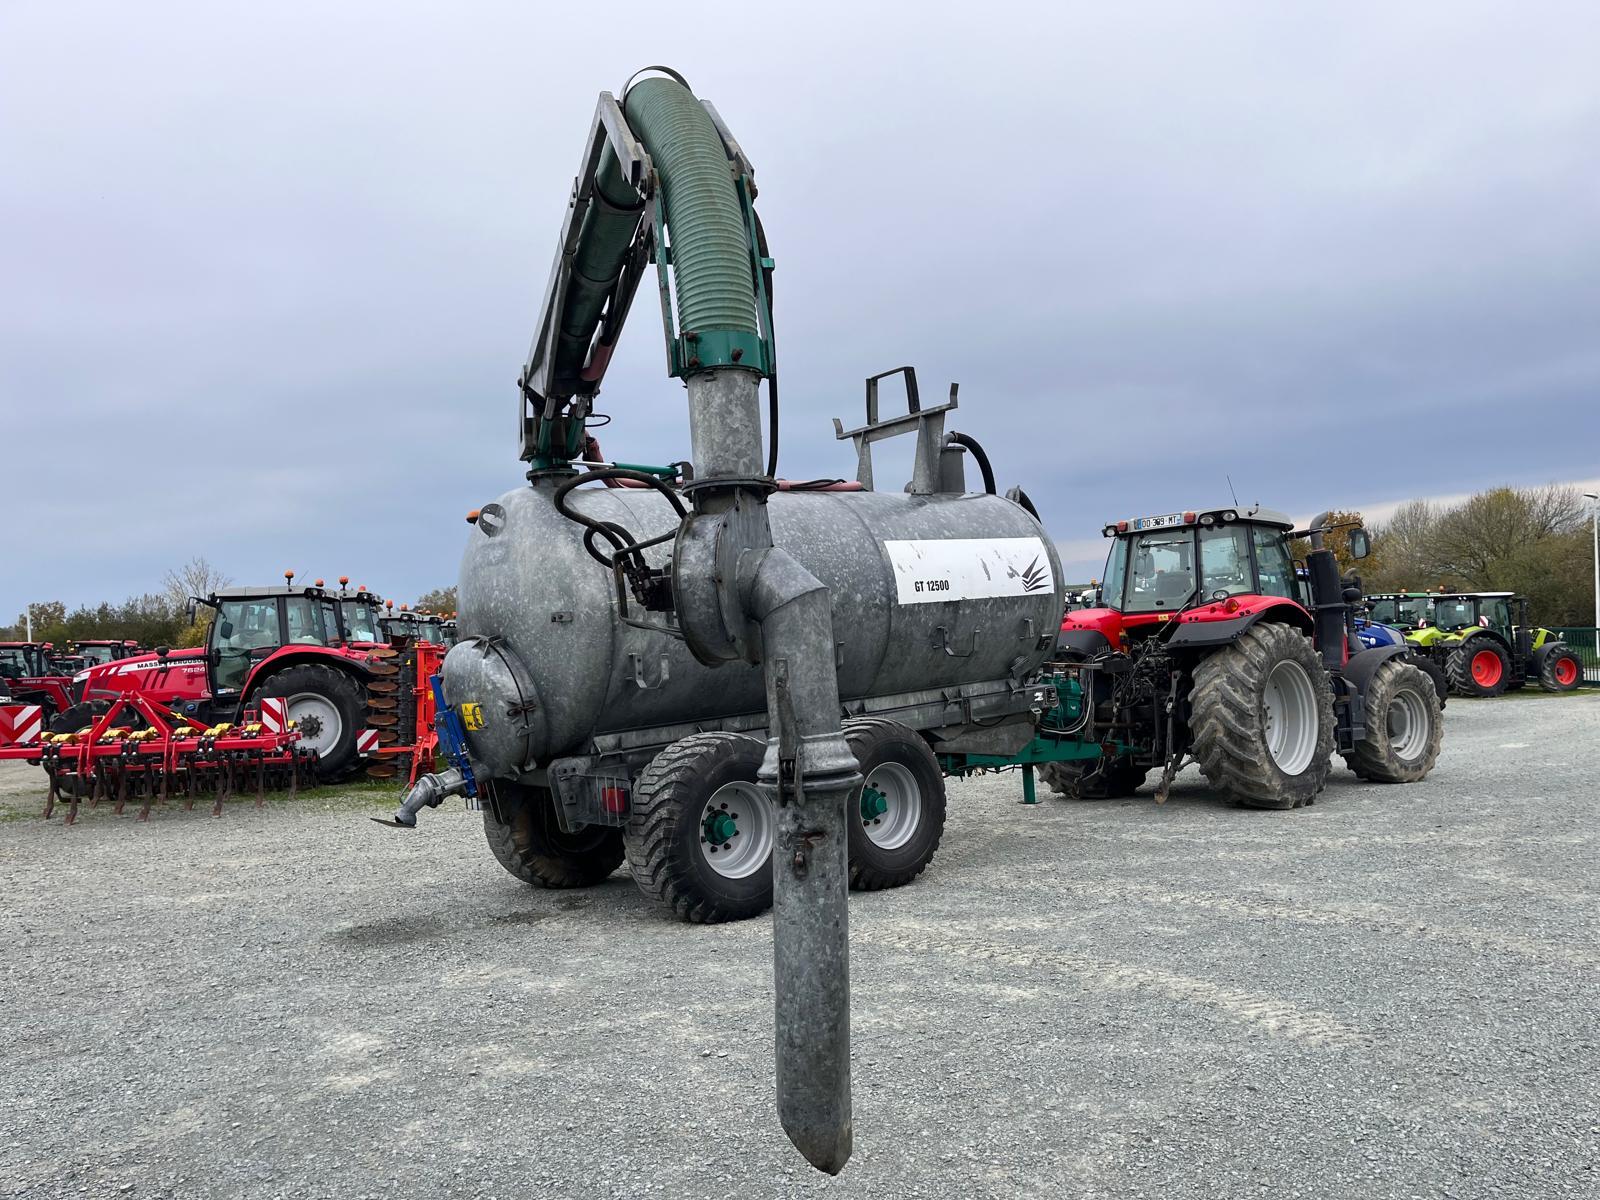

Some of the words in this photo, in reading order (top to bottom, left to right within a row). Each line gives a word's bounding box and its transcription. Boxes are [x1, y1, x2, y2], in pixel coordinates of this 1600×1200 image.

[914, 580, 924, 592] GT
[926, 579, 950, 592] 12500
[137, 661, 164, 669] MASSE
